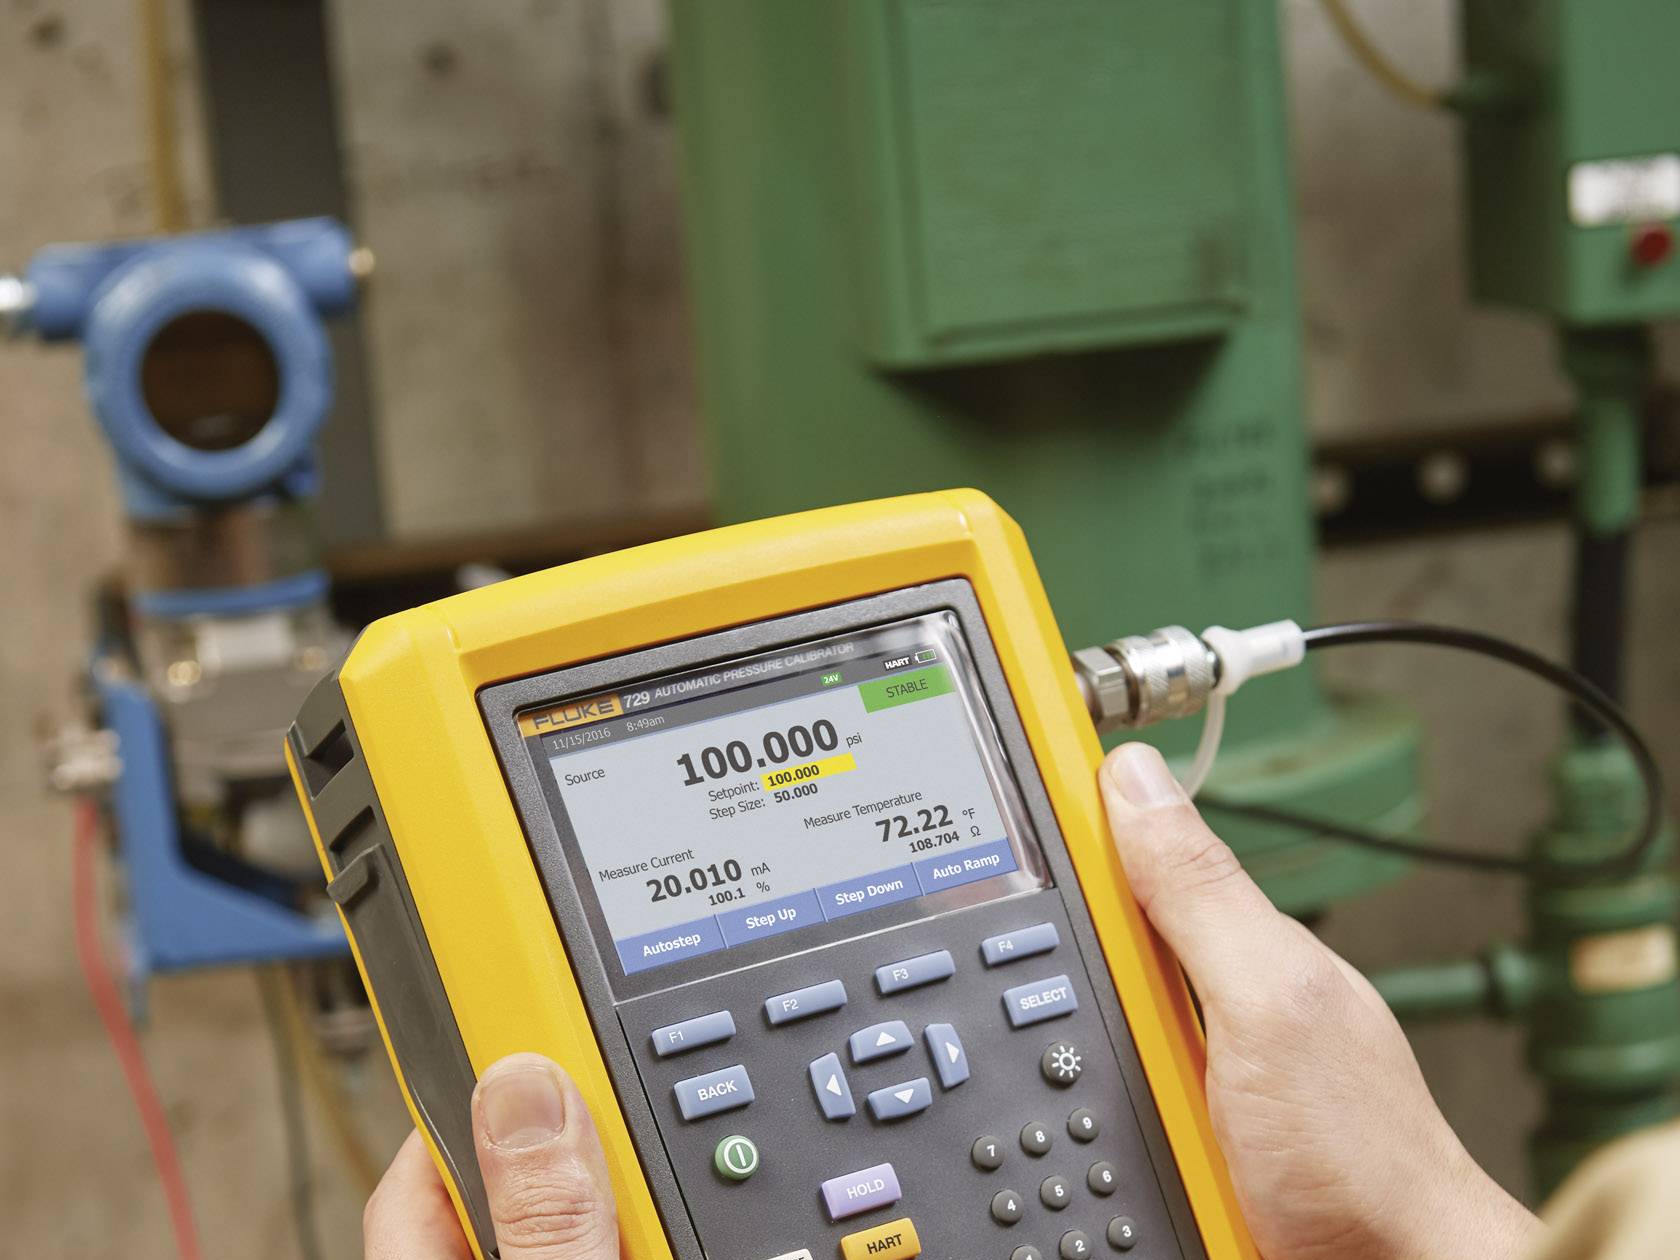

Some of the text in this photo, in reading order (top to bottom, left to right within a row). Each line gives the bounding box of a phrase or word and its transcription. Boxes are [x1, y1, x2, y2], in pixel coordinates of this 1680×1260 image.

[884, 656, 910, 670] HART
[533, 642, 854, 730] FLUKE 729 AUTOMATIC PRESSURE CALIBRATOR
[823, 673, 839, 684] 24V
[886, 678, 928, 698] STABLE
[552, 715, 665, 750] 11/15/2016 8:49am
[676, 719, 863, 787] 100.000 psi
[564, 768, 606, 786] Source
[708, 764, 820, 802] Setpoint: 100.000
[709, 783, 818, 820] Step Size: 50.000
[803, 790, 923, 829] Measure Temperature
[875, 804, 953, 842] 72.22
[909, 830, 960, 853] 108.704
[598, 849, 694, 882] Measure Current
[932, 853, 1000, 880] Auto Ramp
[646, 858, 771, 903] 20.010 mA
[708, 880, 771, 906] 100.1 %
[835, 878, 904, 906] Step Down
[745, 907, 797, 929] Step Up
[643, 933, 701, 957] Autostep
[998, 940, 1014, 953] F4
[892, 968, 909, 981] F3
[782, 999, 799, 1013] F2
[1018, 986, 1068, 1010] SELECT
[669, 1031, 684, 1044] F1
[697, 1079, 738, 1101] BACK
[1082, 1117, 1093, 1130] 9
[1035, 1130, 1046, 1143] 8
[986, 1144, 996, 1157] 7
[1102, 1170, 1113, 1183] 6
[846, 1178, 885, 1200] HOLD
[1054, 1184, 1065, 1197] 5
[1007, 1199, 1017, 1212] 4
[1122, 1225, 1133, 1238] 3
[866, 1233, 904, 1255] HART
[1075, 1239, 1086, 1253] 2
